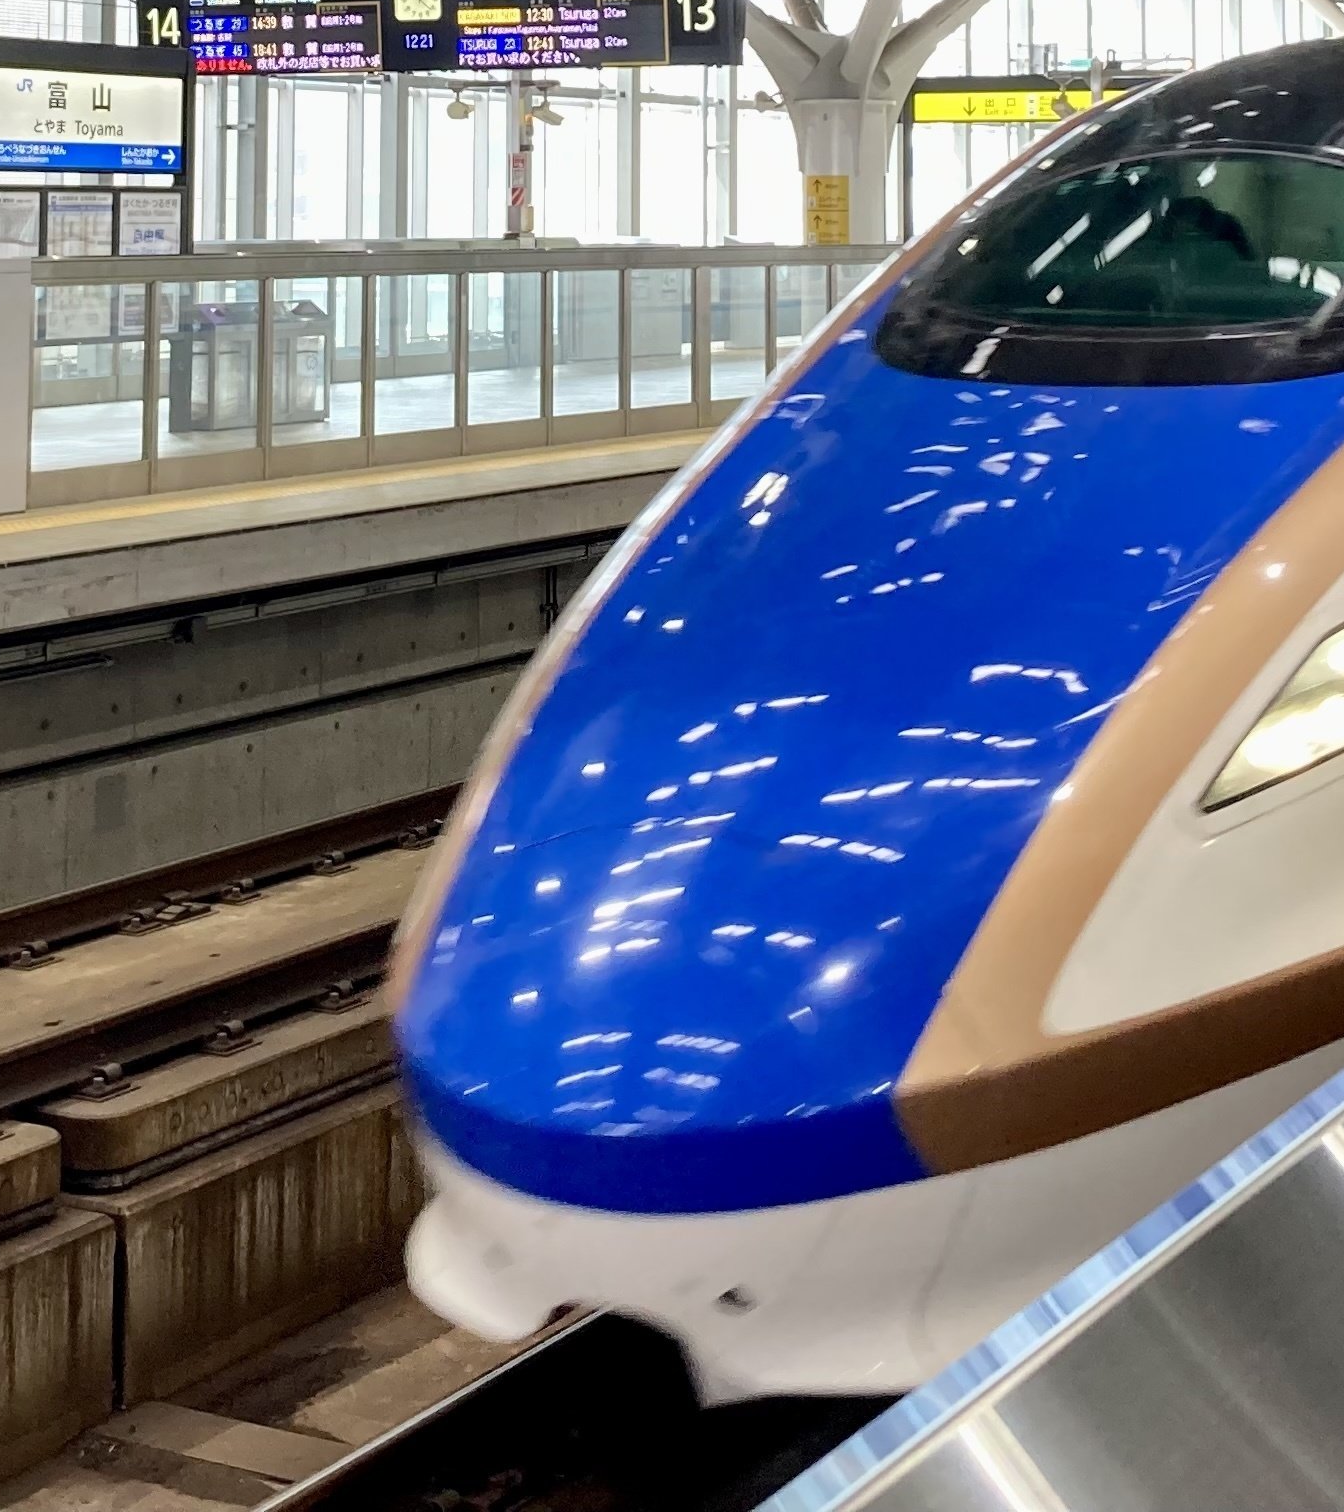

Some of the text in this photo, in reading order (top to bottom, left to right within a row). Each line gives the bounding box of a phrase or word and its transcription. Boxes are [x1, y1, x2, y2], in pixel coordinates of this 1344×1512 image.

[526, 8, 553, 22] 12:30
[558, 7, 599, 21] Tsuruga
[145, 7, 181, 46] 14
[252, 15, 277, 30] 14:39
[252, 42, 277, 57] 18:41
[527, 36, 554, 51] 12:41
[559, 35, 600, 50] Tsuruga
[16, 78, 33, 93] JR
[47, 80, 112, 113] 富山
[33, 119, 124, 140] とやま Toyama
